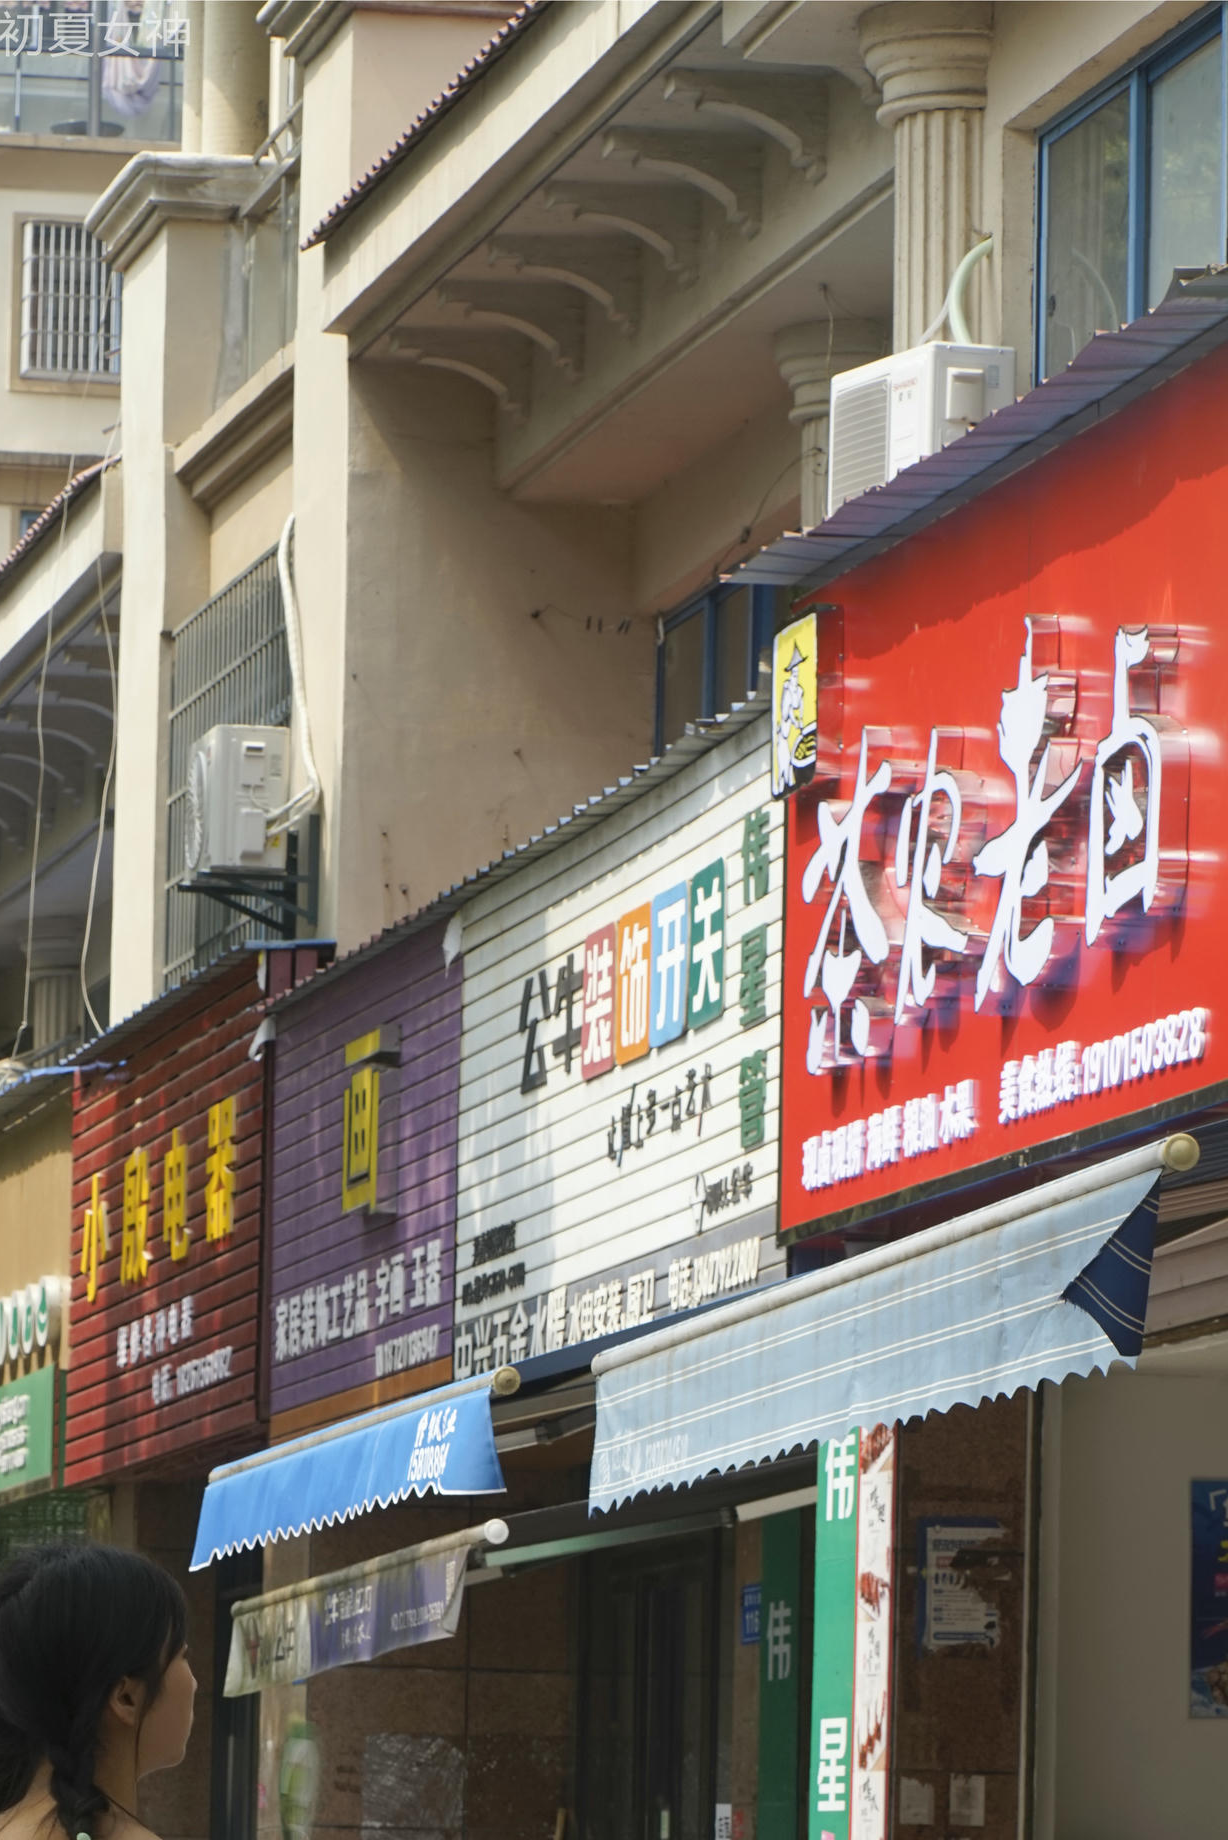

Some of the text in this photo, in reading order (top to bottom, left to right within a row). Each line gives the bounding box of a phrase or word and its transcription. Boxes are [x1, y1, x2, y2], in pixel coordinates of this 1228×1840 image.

[519, 874, 723, 1094] 公牛装饰开关
[375, 1253, 406, 1325] 字画
[454, 1286, 568, 1382] 中兴五金水暖
